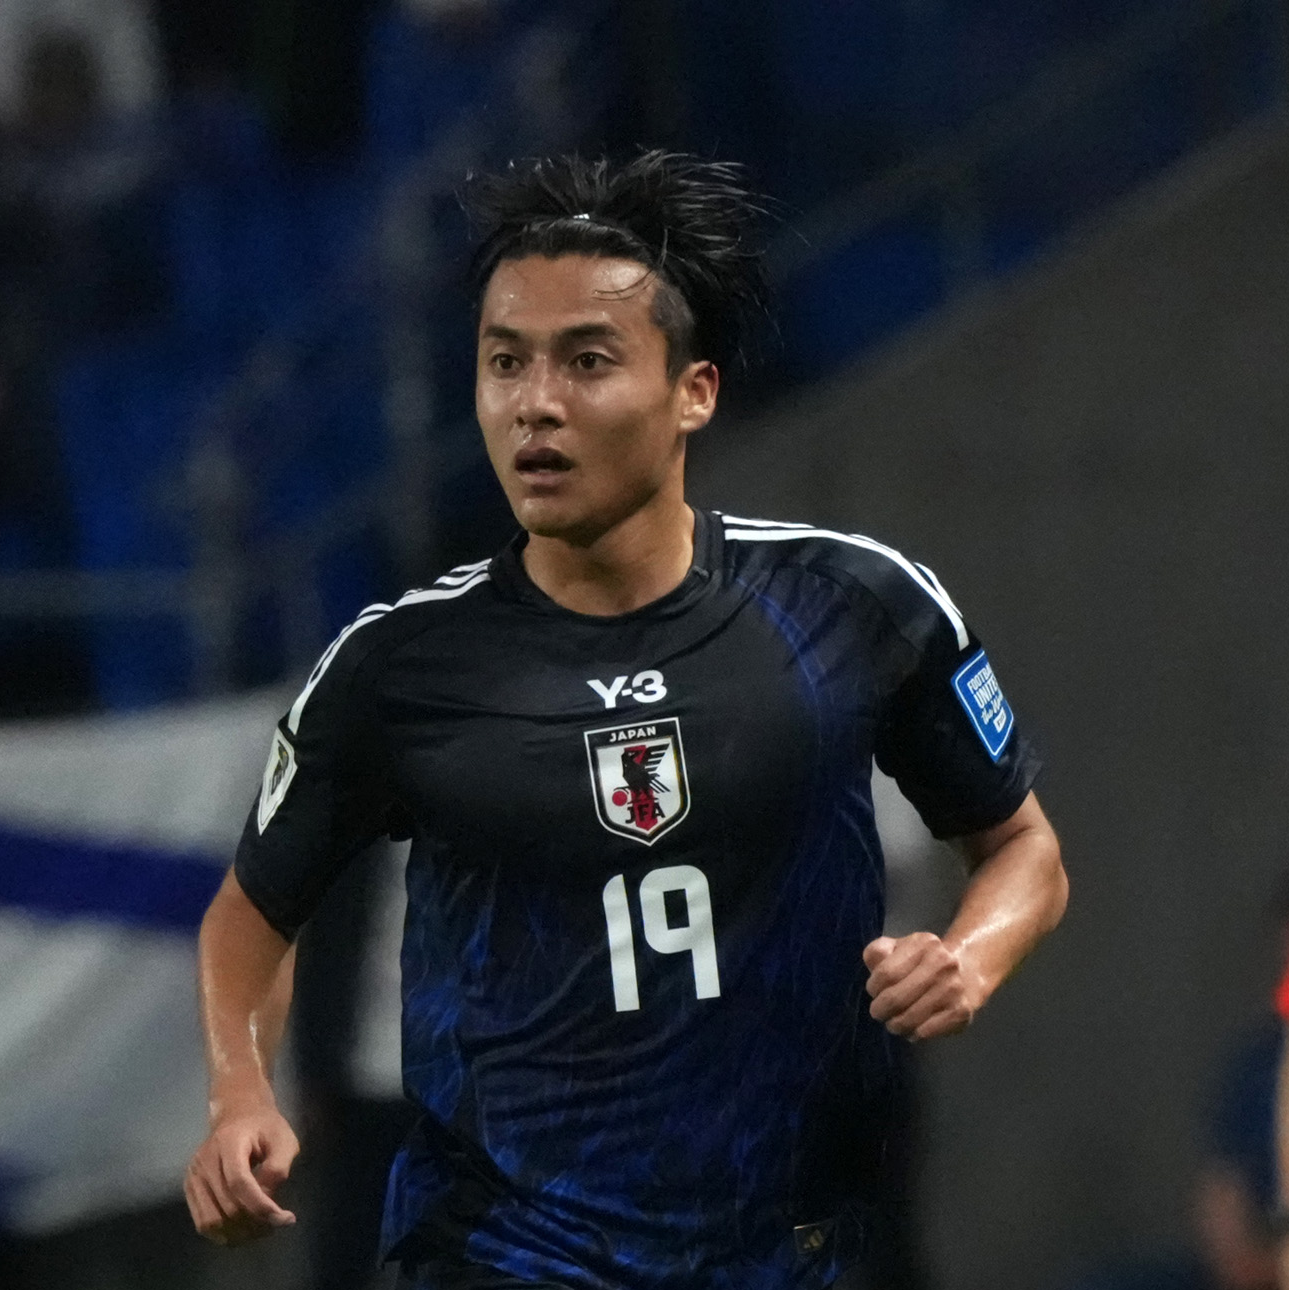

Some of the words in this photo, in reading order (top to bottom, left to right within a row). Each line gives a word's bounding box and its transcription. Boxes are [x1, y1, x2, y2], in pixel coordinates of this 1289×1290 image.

[586, 669, 667, 709] Y-3
[966, 661, 993, 695] FOOTBA
[609, 725, 657, 743] JAPAN
[625, 801, 666, 824] JFA
[602, 864, 721, 1013] 19
